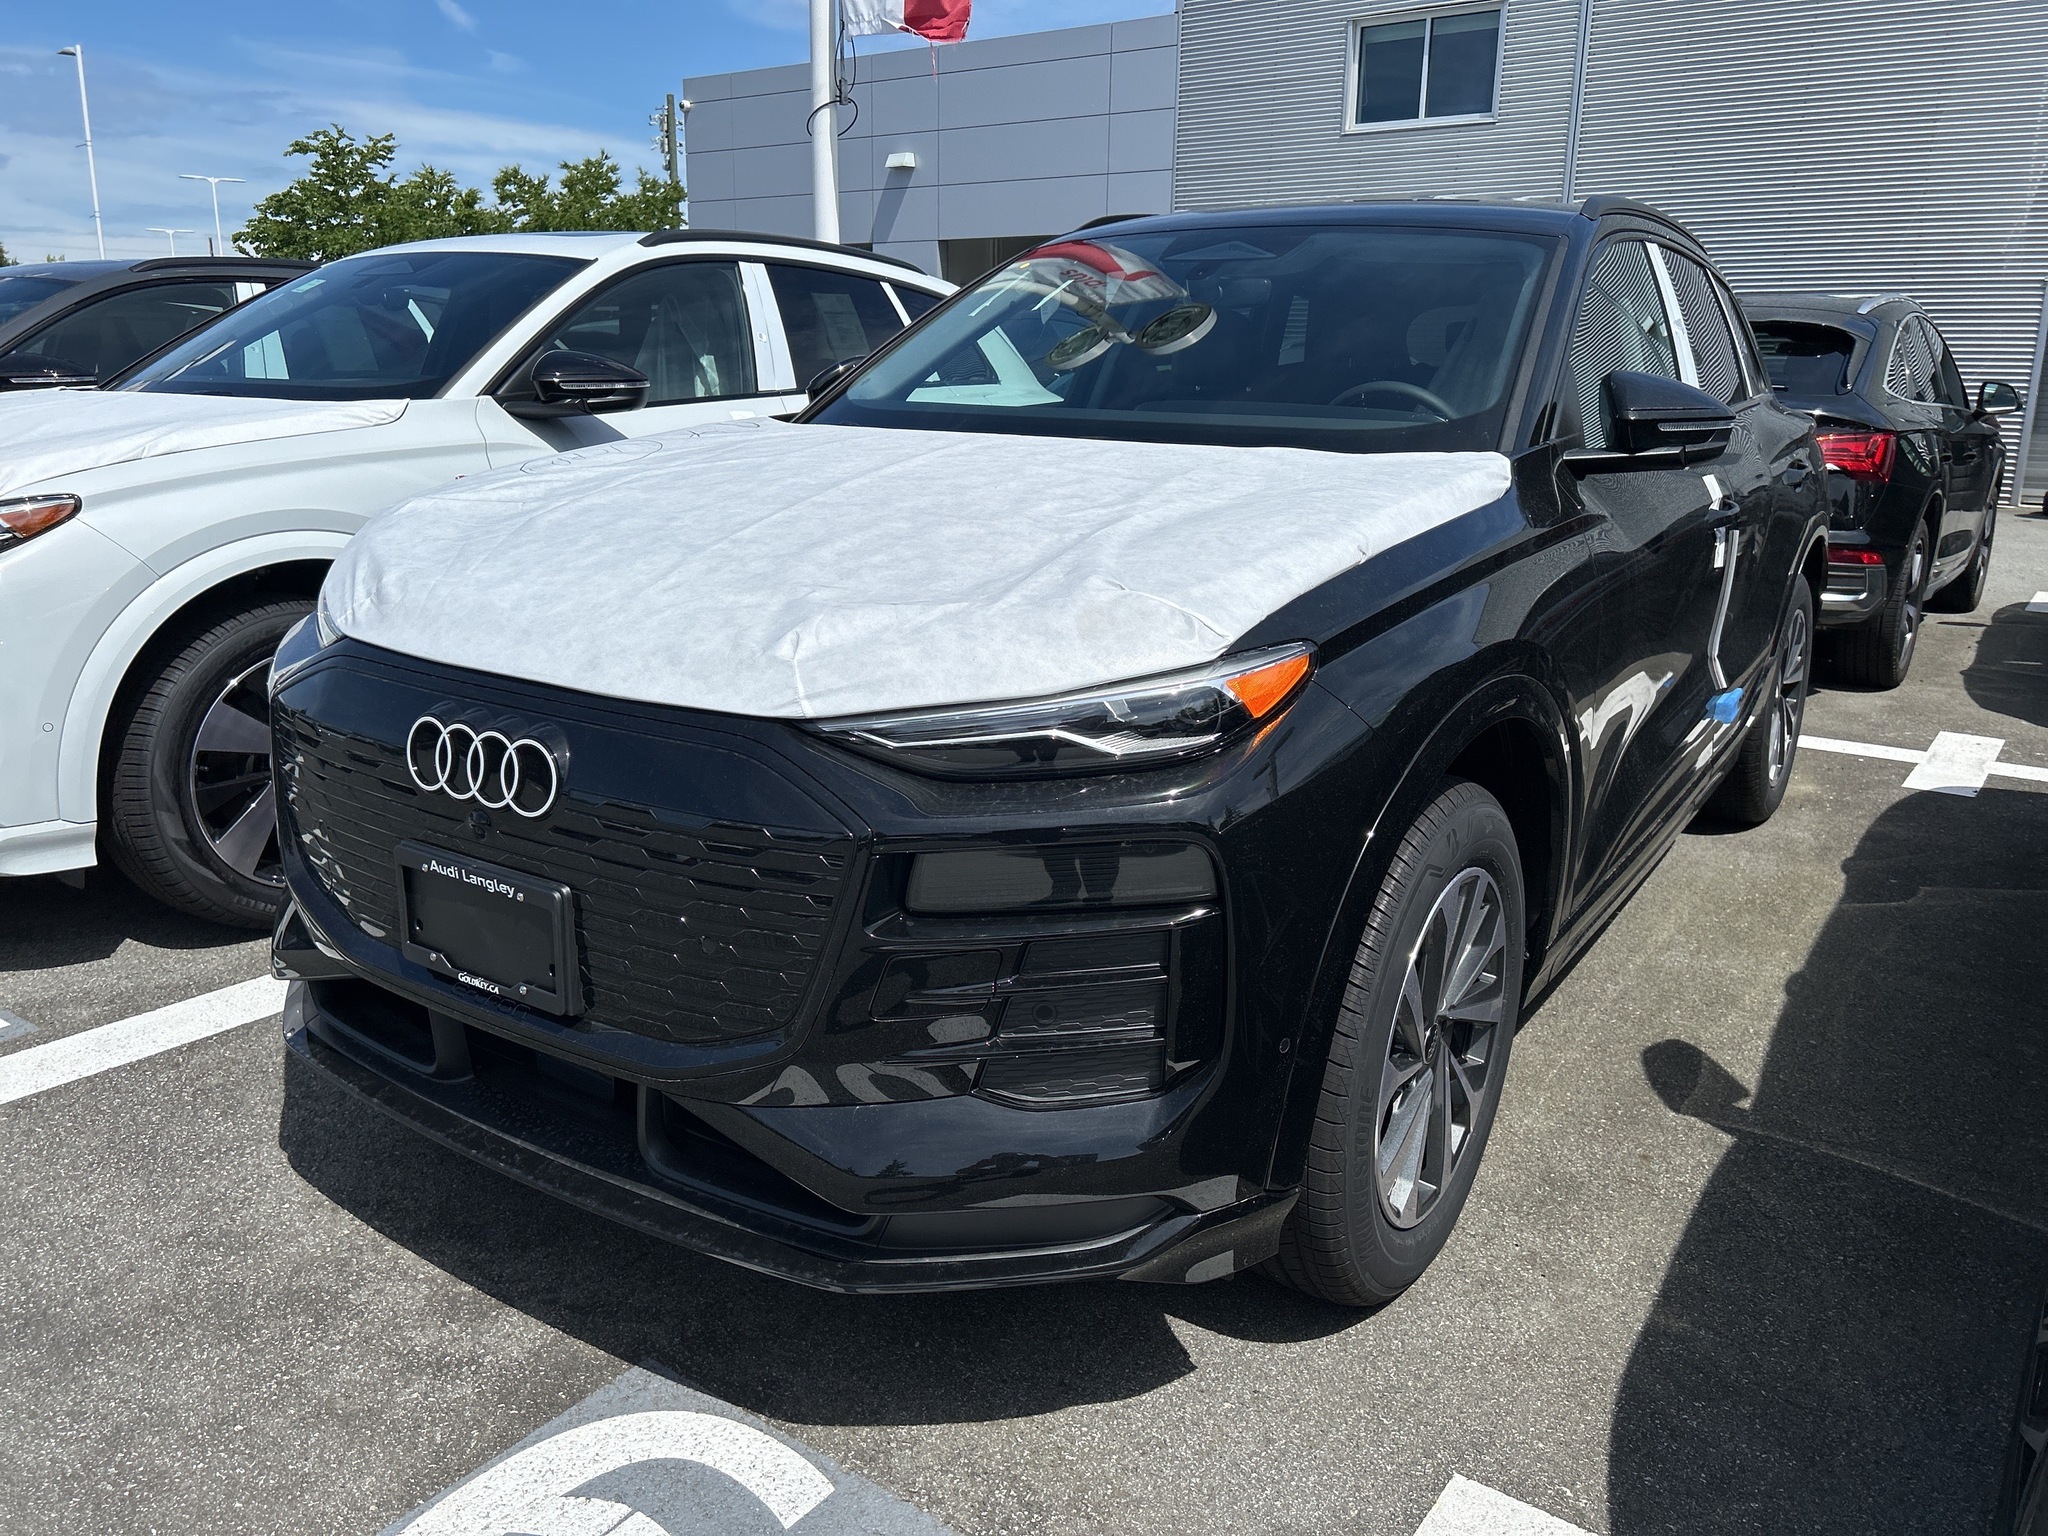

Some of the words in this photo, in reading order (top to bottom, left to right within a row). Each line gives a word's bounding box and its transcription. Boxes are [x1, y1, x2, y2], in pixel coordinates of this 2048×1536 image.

[430, 860, 459, 879] Audi
[462, 869, 515, 898] Langley
[233, 895, 278, 914] RELLI
